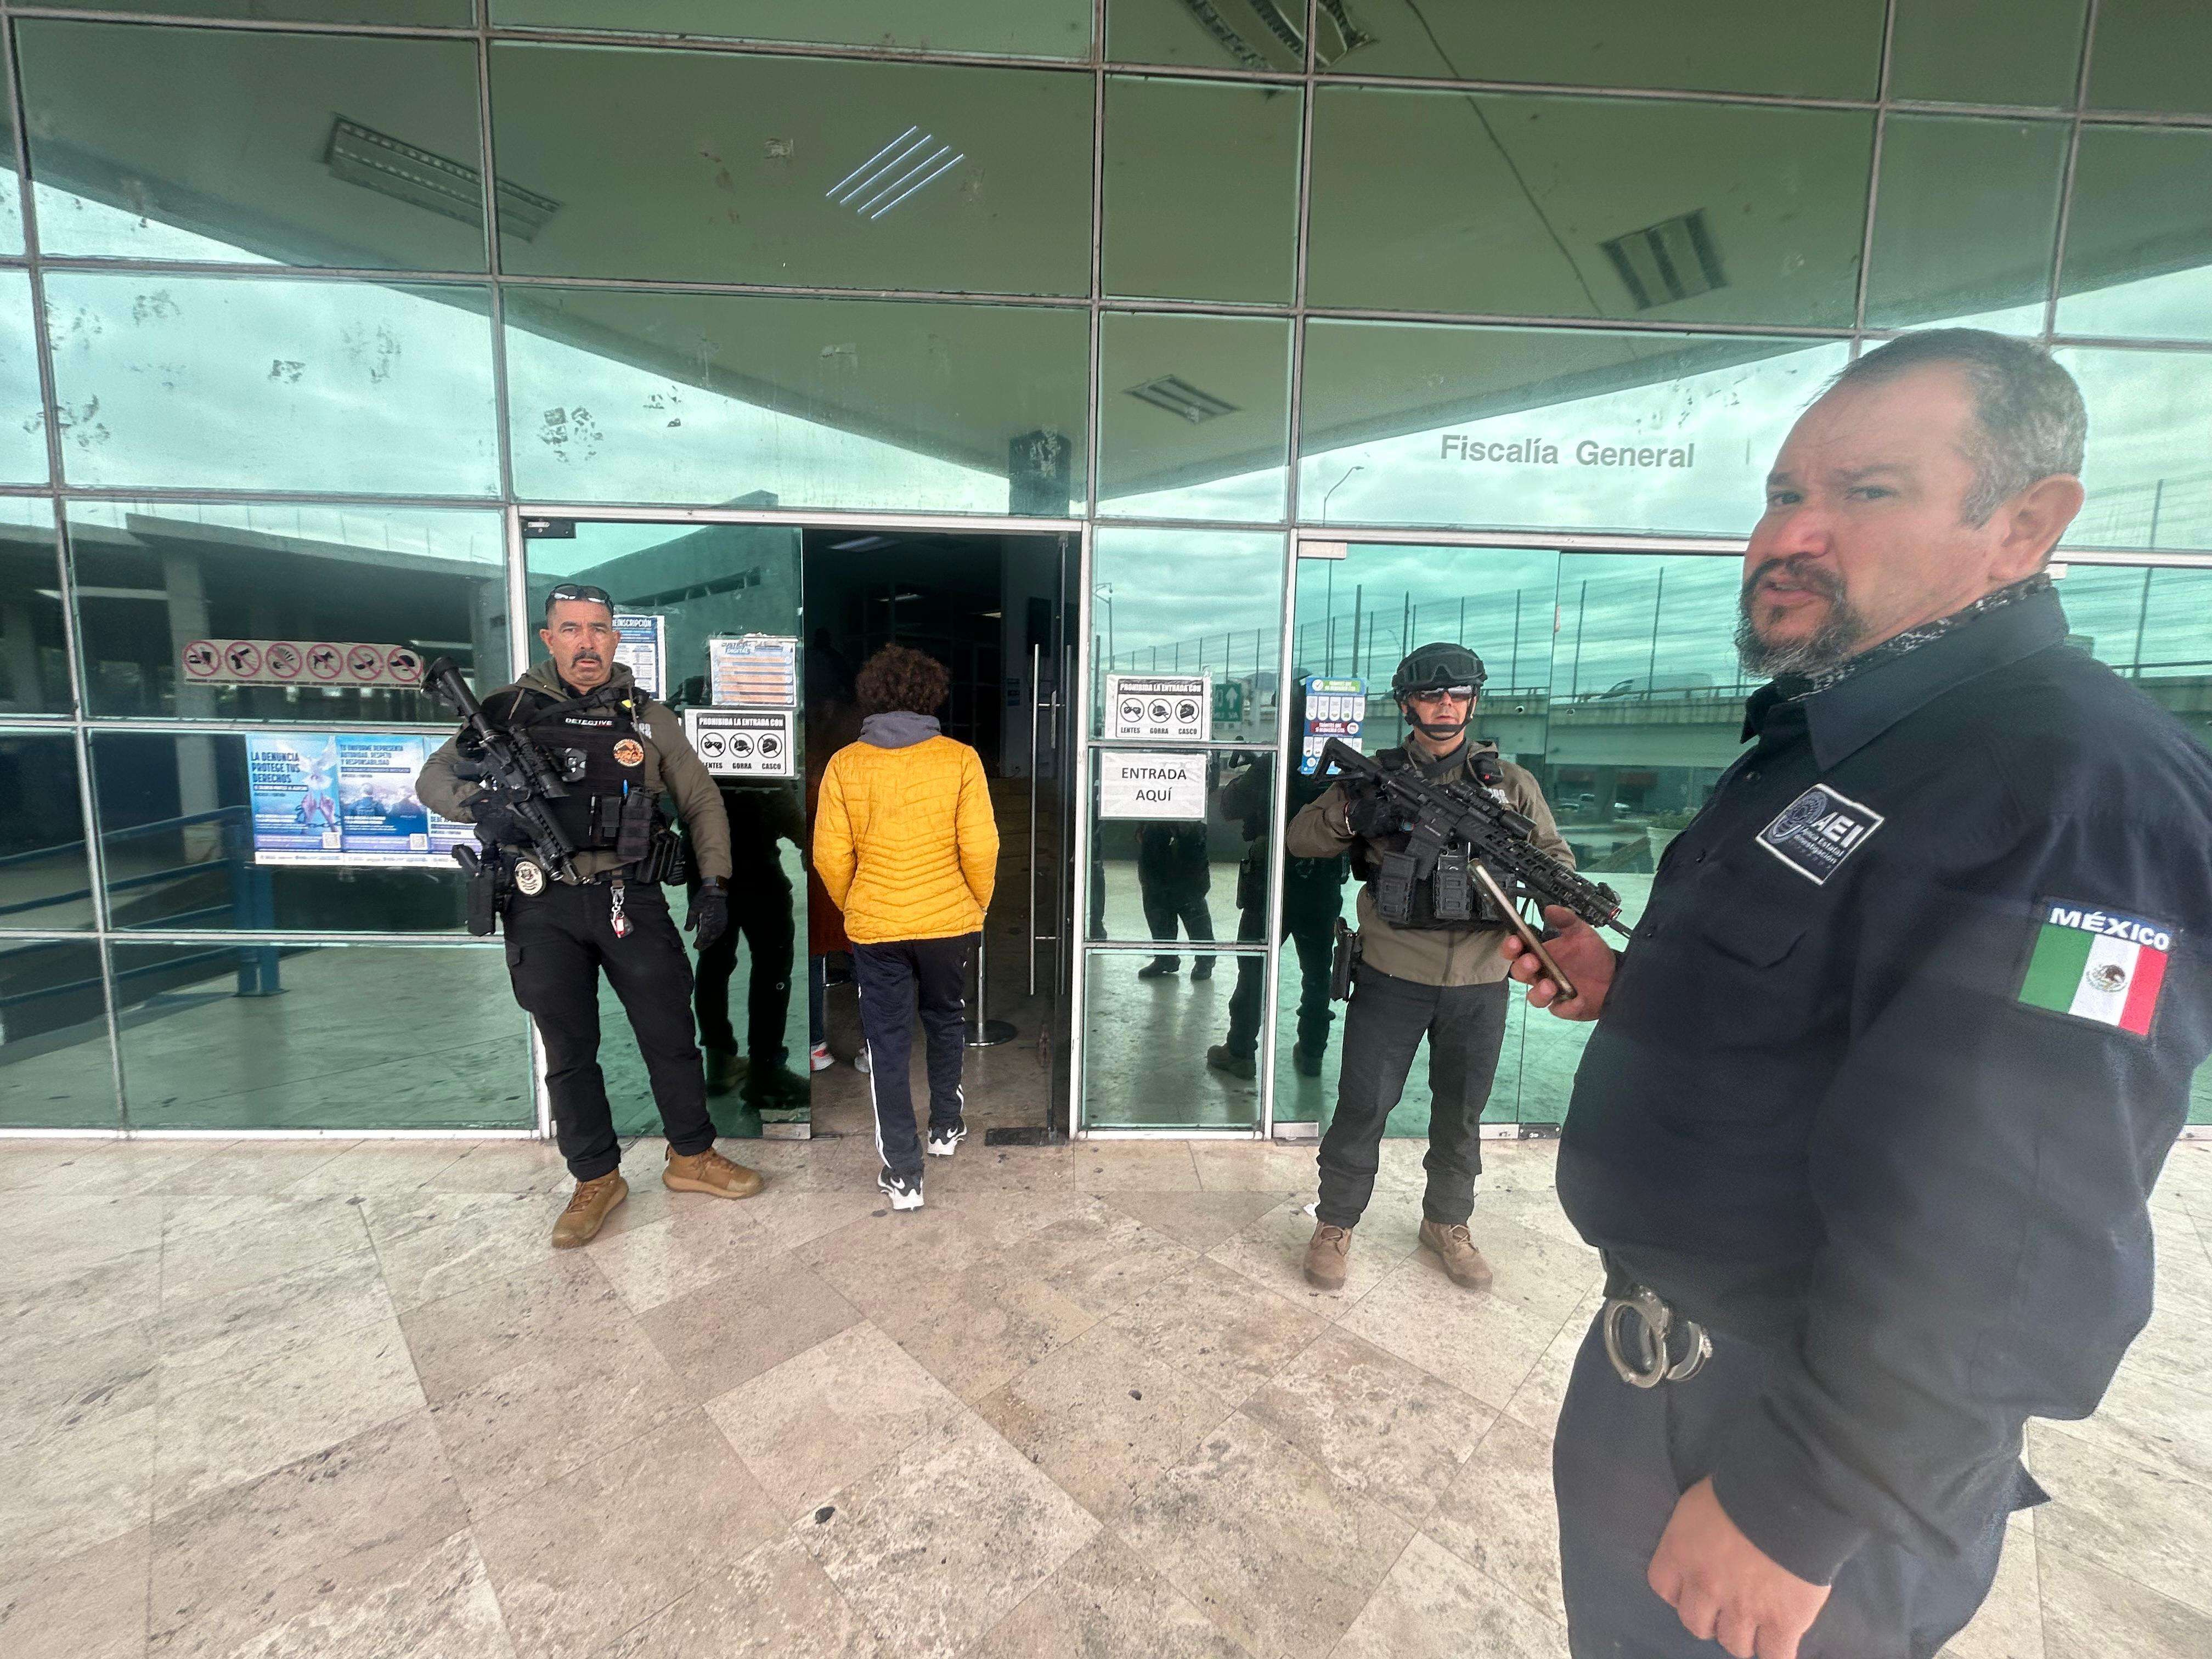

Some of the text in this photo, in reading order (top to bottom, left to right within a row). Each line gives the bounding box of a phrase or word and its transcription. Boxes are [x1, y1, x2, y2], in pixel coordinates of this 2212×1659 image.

[1441, 435, 1694, 467] Fiscalía General
[1120, 683, 1152, 691] PROHIBIDA
[1161, 684, 1188, 692] ENTRADA
[1188, 684, 1201, 692] CON
[565, 718, 613, 726] DETECTIVE
[699, 718, 733, 726] PROHIBIDA
[742, 718, 770, 726] ENTRADA
[770, 719, 783, 727] CON
[251, 752, 300, 761] LA DENUNCIA
[252, 763, 301, 772] PROTEGE TUS
[253, 773, 292, 783] DERECHOS
[1121, 768, 1187, 780] ENTRADA
[1136, 787, 1171, 803] AQUÍ
[1811, 811, 1865, 848] AEI
[2049, 907, 2169, 950] MÉXICO
